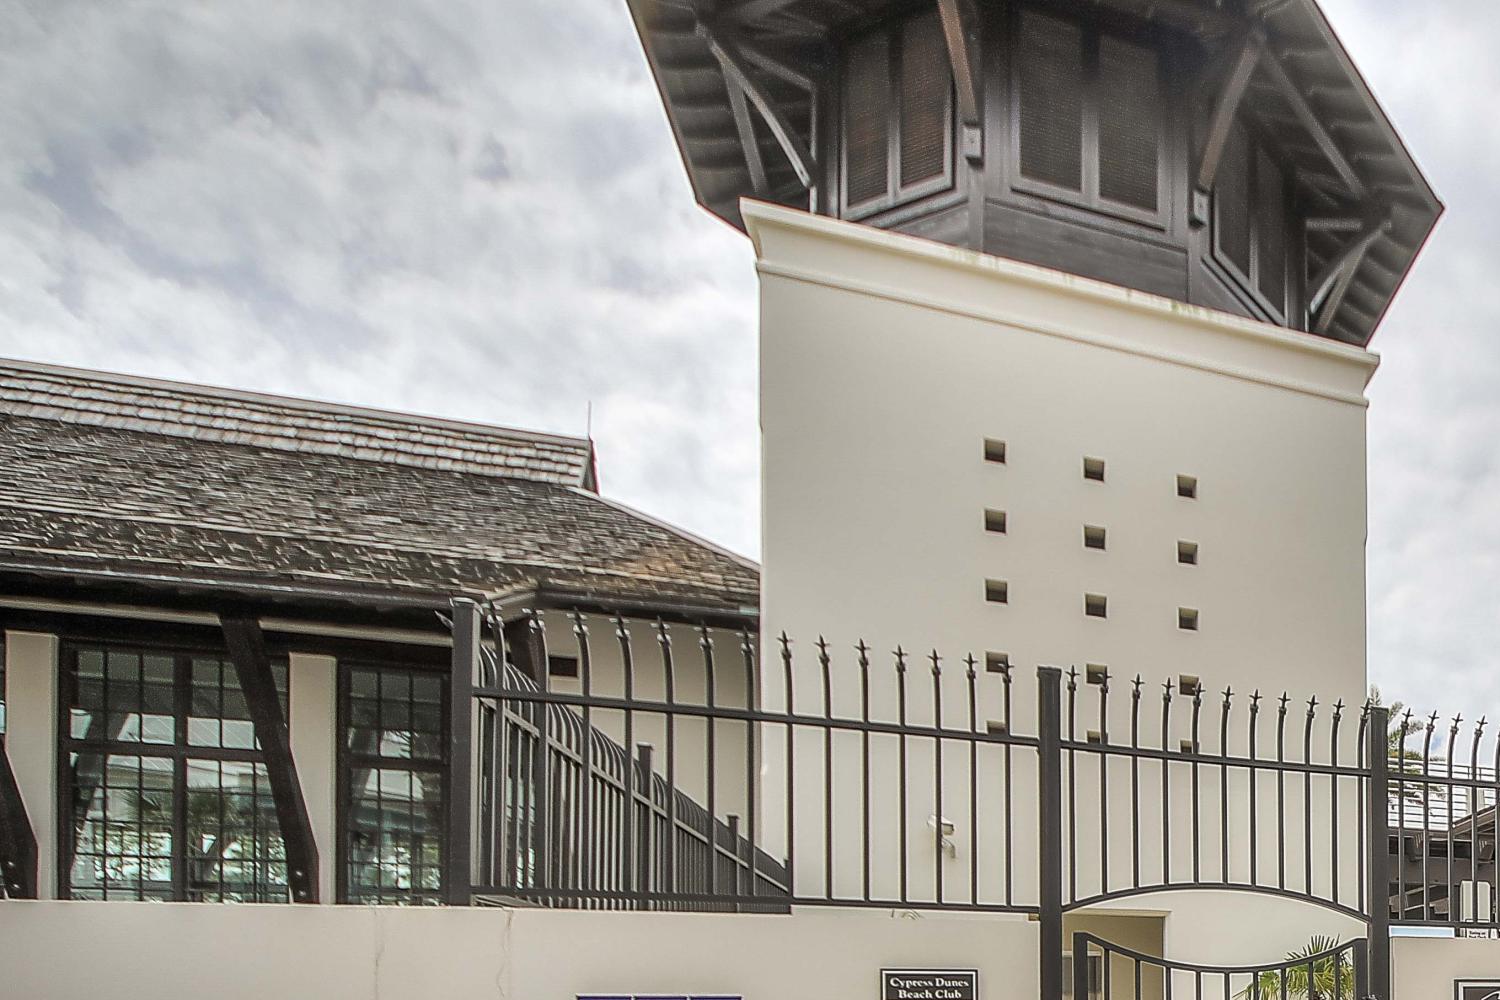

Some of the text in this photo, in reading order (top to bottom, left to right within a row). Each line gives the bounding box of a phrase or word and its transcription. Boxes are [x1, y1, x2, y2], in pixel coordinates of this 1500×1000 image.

[890, 977, 969, 988] Cypress Dunes
[898, 988, 962, 999] Beach Club
